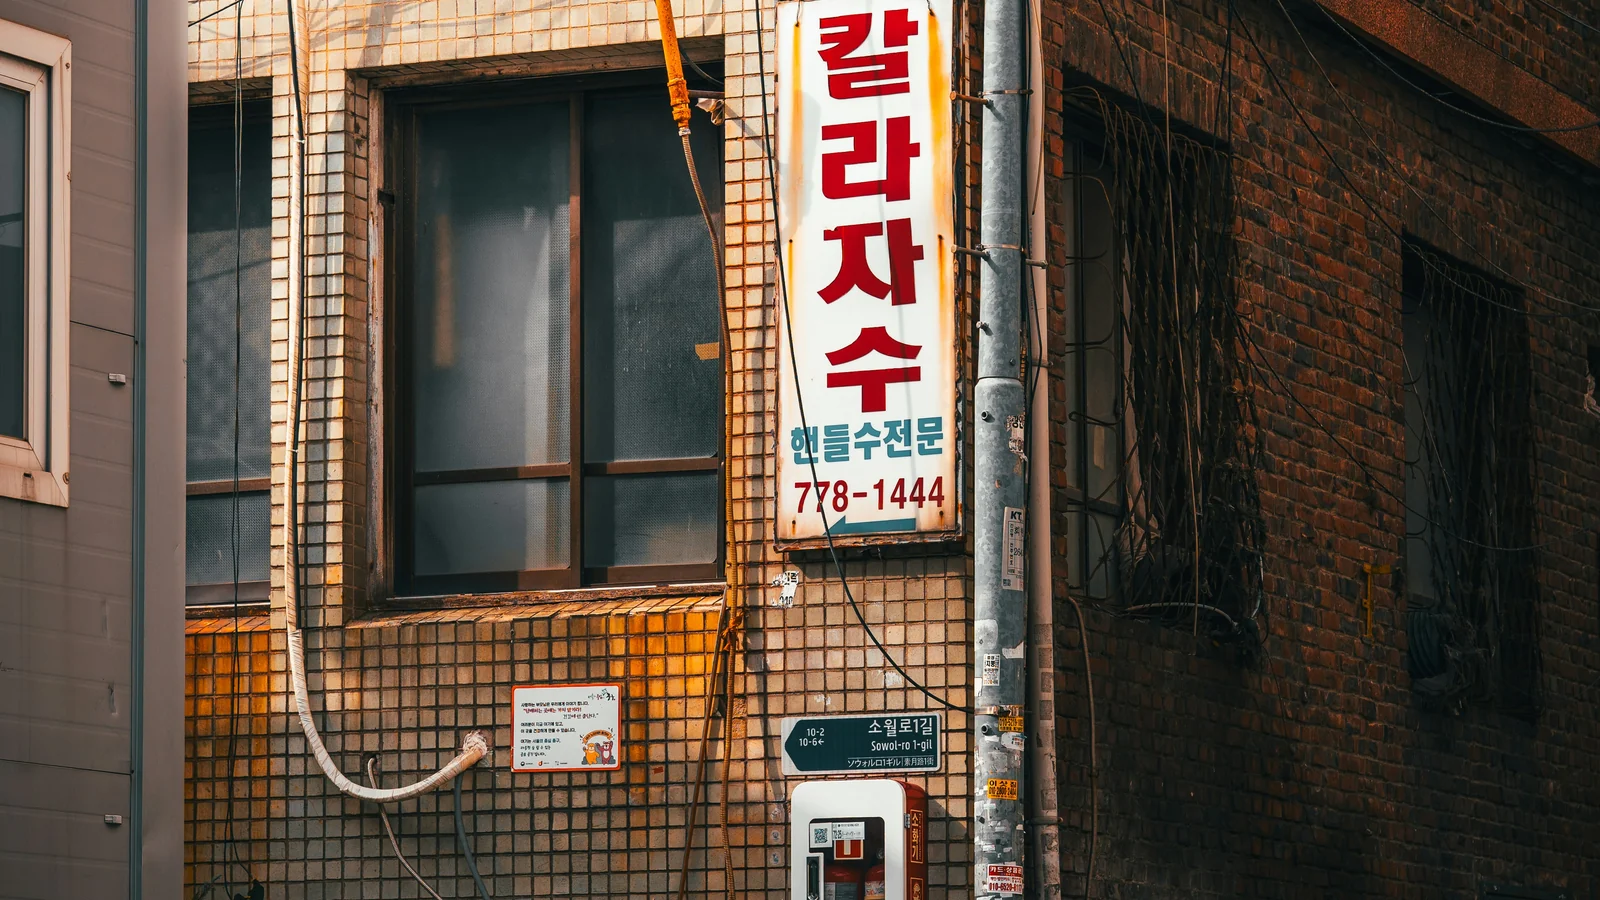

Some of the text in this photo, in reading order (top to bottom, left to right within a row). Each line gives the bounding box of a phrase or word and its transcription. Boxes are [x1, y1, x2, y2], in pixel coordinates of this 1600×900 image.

[817, 9, 924, 413] 칼라자수
[791, 417, 943, 464] 핸들수전문
[794, 476, 945, 513] 778-1444
[1011, 511, 1021, 520] KT
[806, 728, 825, 737] 10-2
[868, 718, 933, 737] 소월로1길
[799, 738, 818, 747] 10-6
[871, 739, 932, 752] Sowol-ro 1-gil
[848, 758, 901, 768] ソウォルロ1ギル
[904, 757, 934, 767] 素月路1街
